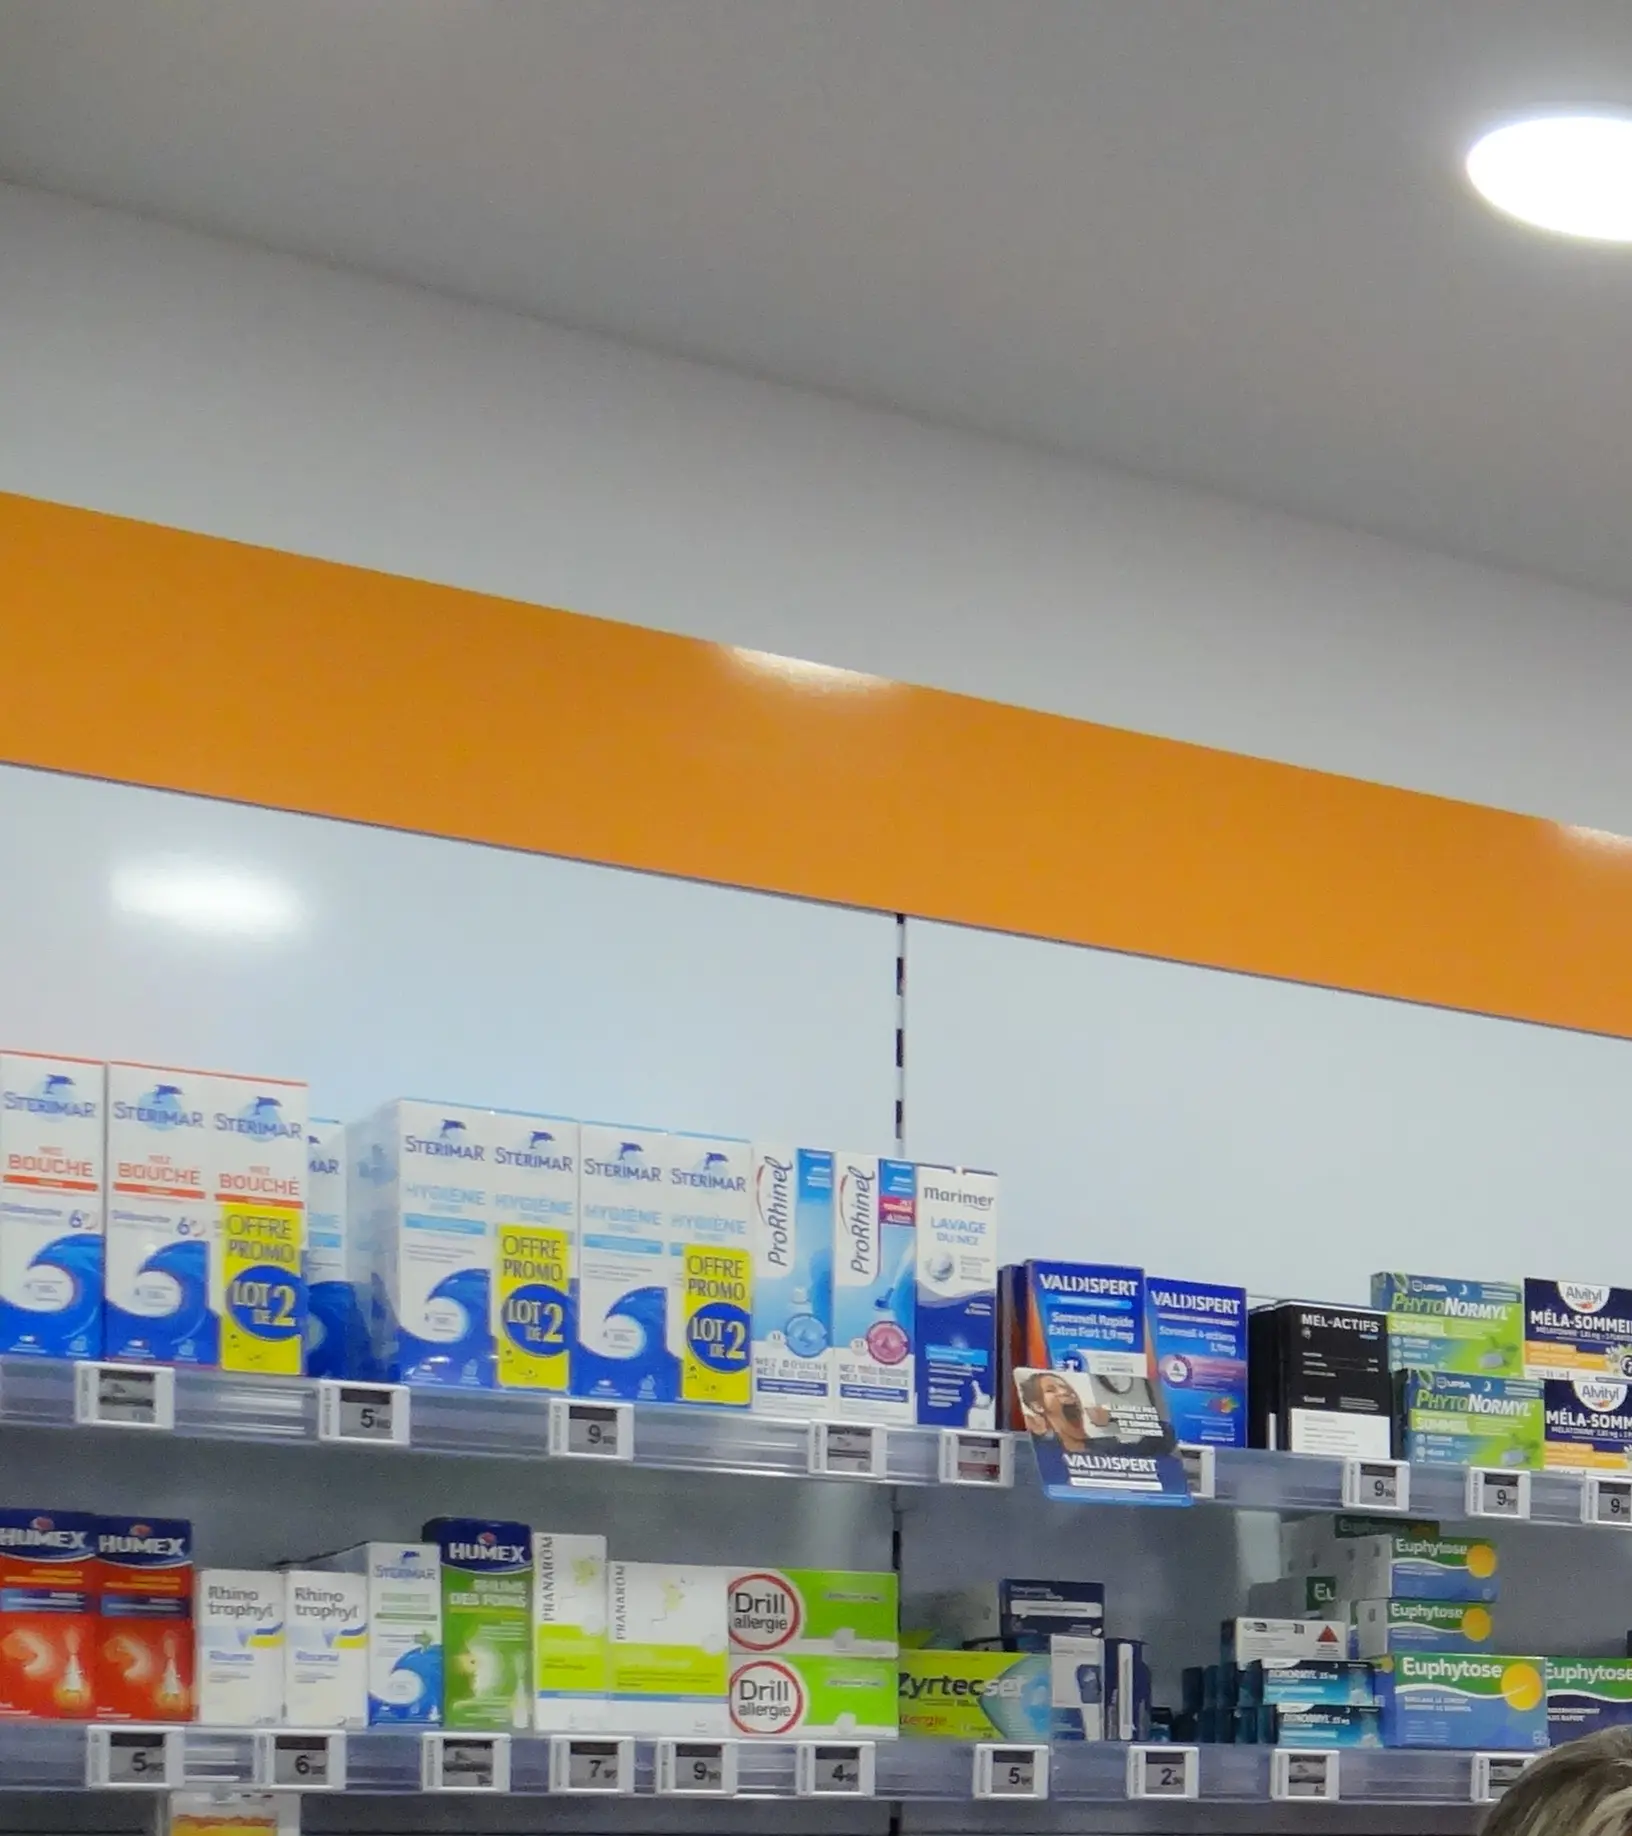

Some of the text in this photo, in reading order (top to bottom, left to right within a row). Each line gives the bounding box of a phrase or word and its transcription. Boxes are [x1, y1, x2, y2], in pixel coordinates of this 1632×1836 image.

[764, 1155, 793, 1266] ProRhinel
[847, 1165, 875, 1275] ProRhinel
[228, 1214, 292, 1240] OFFRE
[930, 1216, 986, 1235] LAVAGE
[228, 1241, 295, 1263] PROMO
[503, 1234, 561, 1260] OFFRE
[503, 1259, 563, 1281] PROMO
[687, 1255, 744, 1279] OFFRE
[233, 1282, 269, 1305] LOT
[688, 1278, 745, 1301] PROMO
[1039, 1273, 1138, 1296] VALDISPERT
[1565, 1285, 1601, 1304] Alvityl
[273, 1286, 296, 1326] 2
[508, 1299, 541, 1324] LOT
[1150, 1291, 1240, 1314] VALDISPERT
[543, 1303, 564, 1343] 2
[693, 1317, 725, 1341] LOT
[726, 1321, 746, 1360] 2
[1582, 1385, 1620, 1403] Alvityl
[1063, 1453, 1157, 1472] VALDISPERT
[0, 1526, 87, 1549] HUMEX
[99, 1534, 183, 1557] HUMEX
[1395, 1538, 1468, 1560] Euphytose
[449, 1543, 525, 1563] HUMEX
[542, 1536, 554, 1621] PRANAROM
[208, 1584, 260, 1602] Rhino
[295, 1584, 346, 1602] Rhino
[615, 1566, 626, 1640] PRANAROM
[734, 1593, 786, 1614] Drill
[207, 1600, 274, 1622] trophyl
[294, 1602, 359, 1623] trophyl
[1391, 1603, 1464, 1622] Euphytose
[734, 1615, 787, 1632] allergie
[1403, 1661, 1502, 1684] Euphytose
[740, 1680, 789, 1701] Drill
[739, 1702, 791, 1720] allergie
